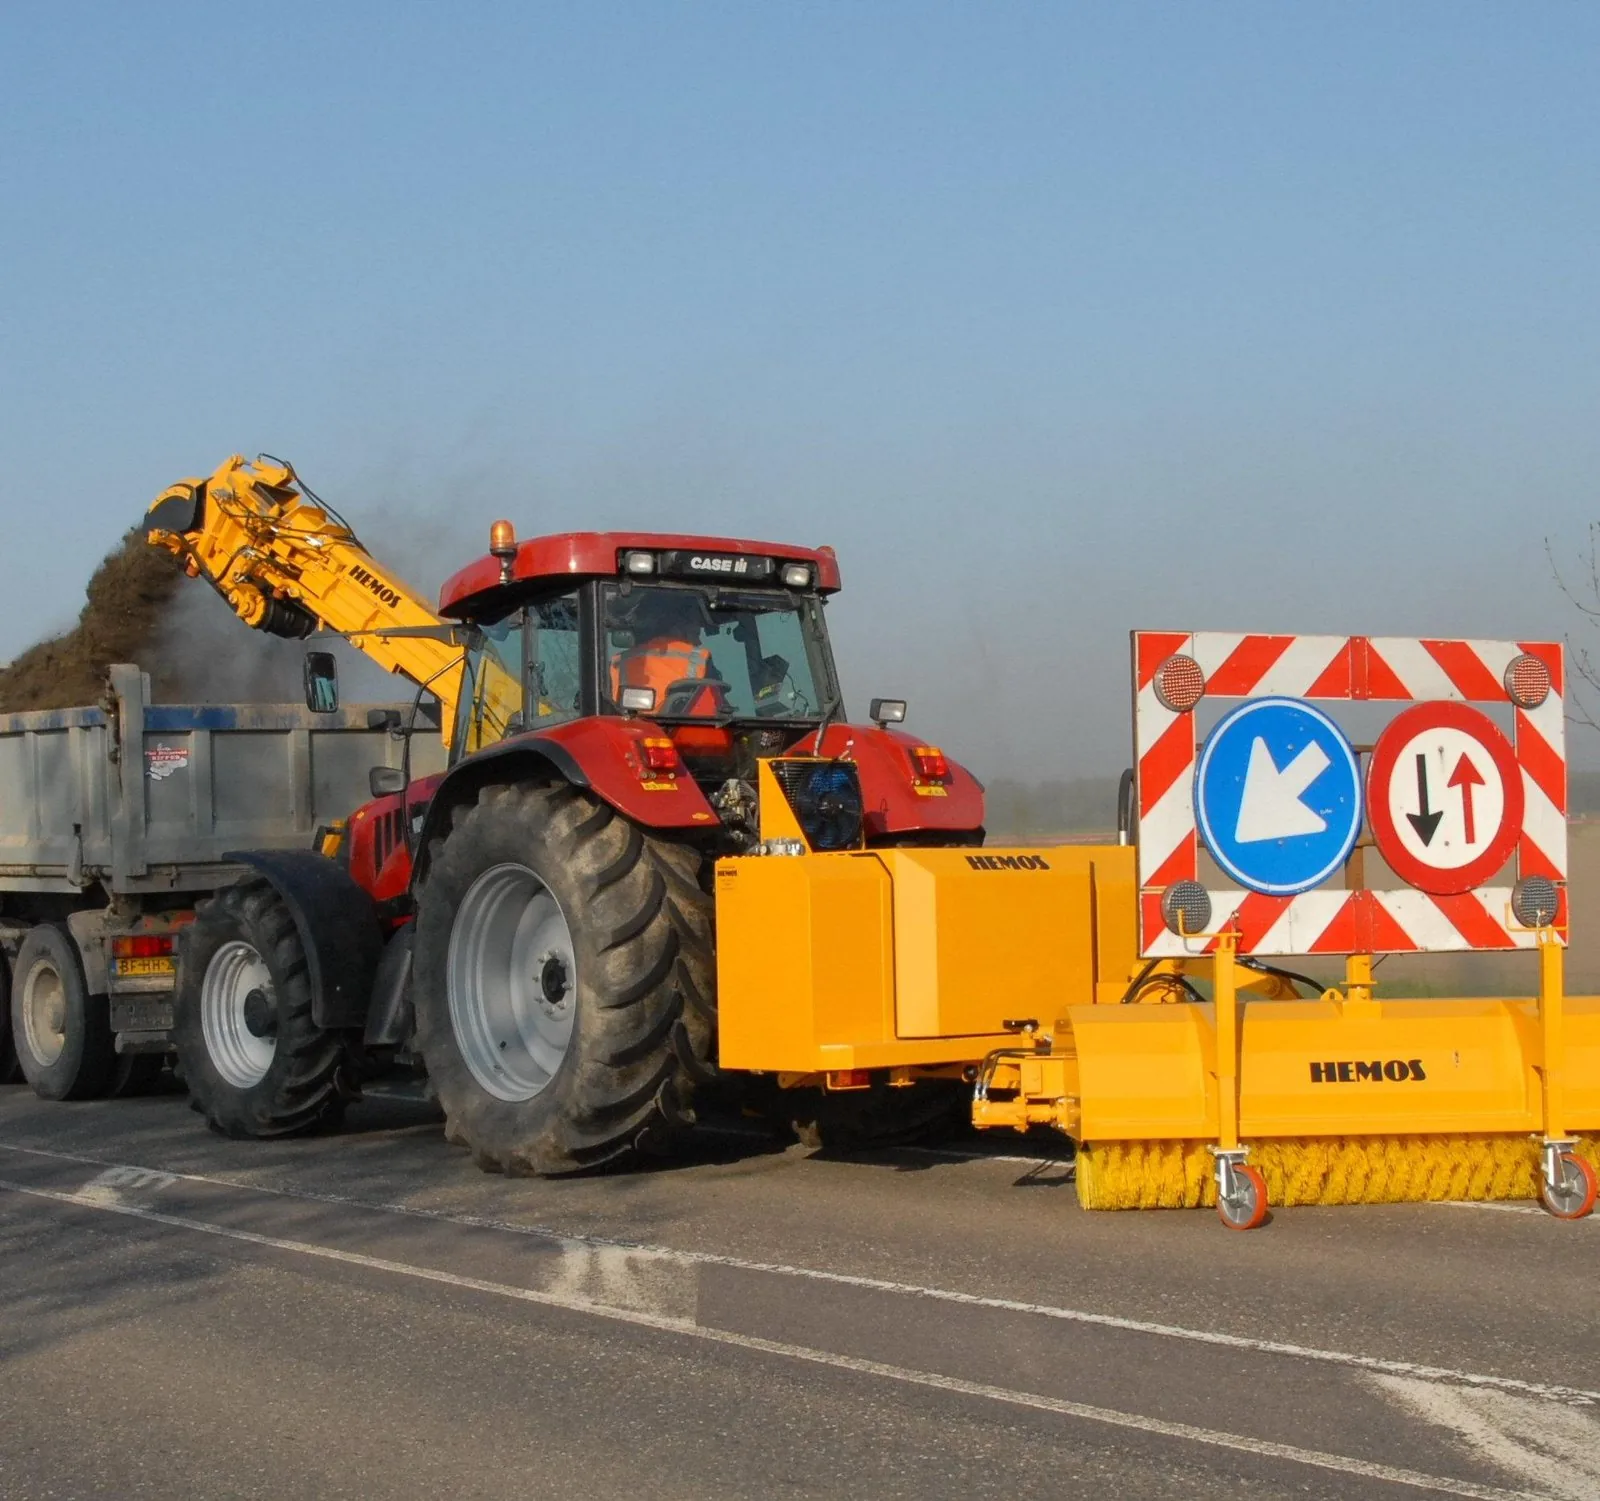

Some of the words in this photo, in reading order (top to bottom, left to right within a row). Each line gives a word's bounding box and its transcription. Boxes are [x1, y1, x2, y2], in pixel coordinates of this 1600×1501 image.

[690, 556, 733, 572] CASE
[348, 564, 402, 608] HEMOS
[964, 855, 1050, 870] HEMOS
[1309, 1059, 1427, 1083] HEMOS
